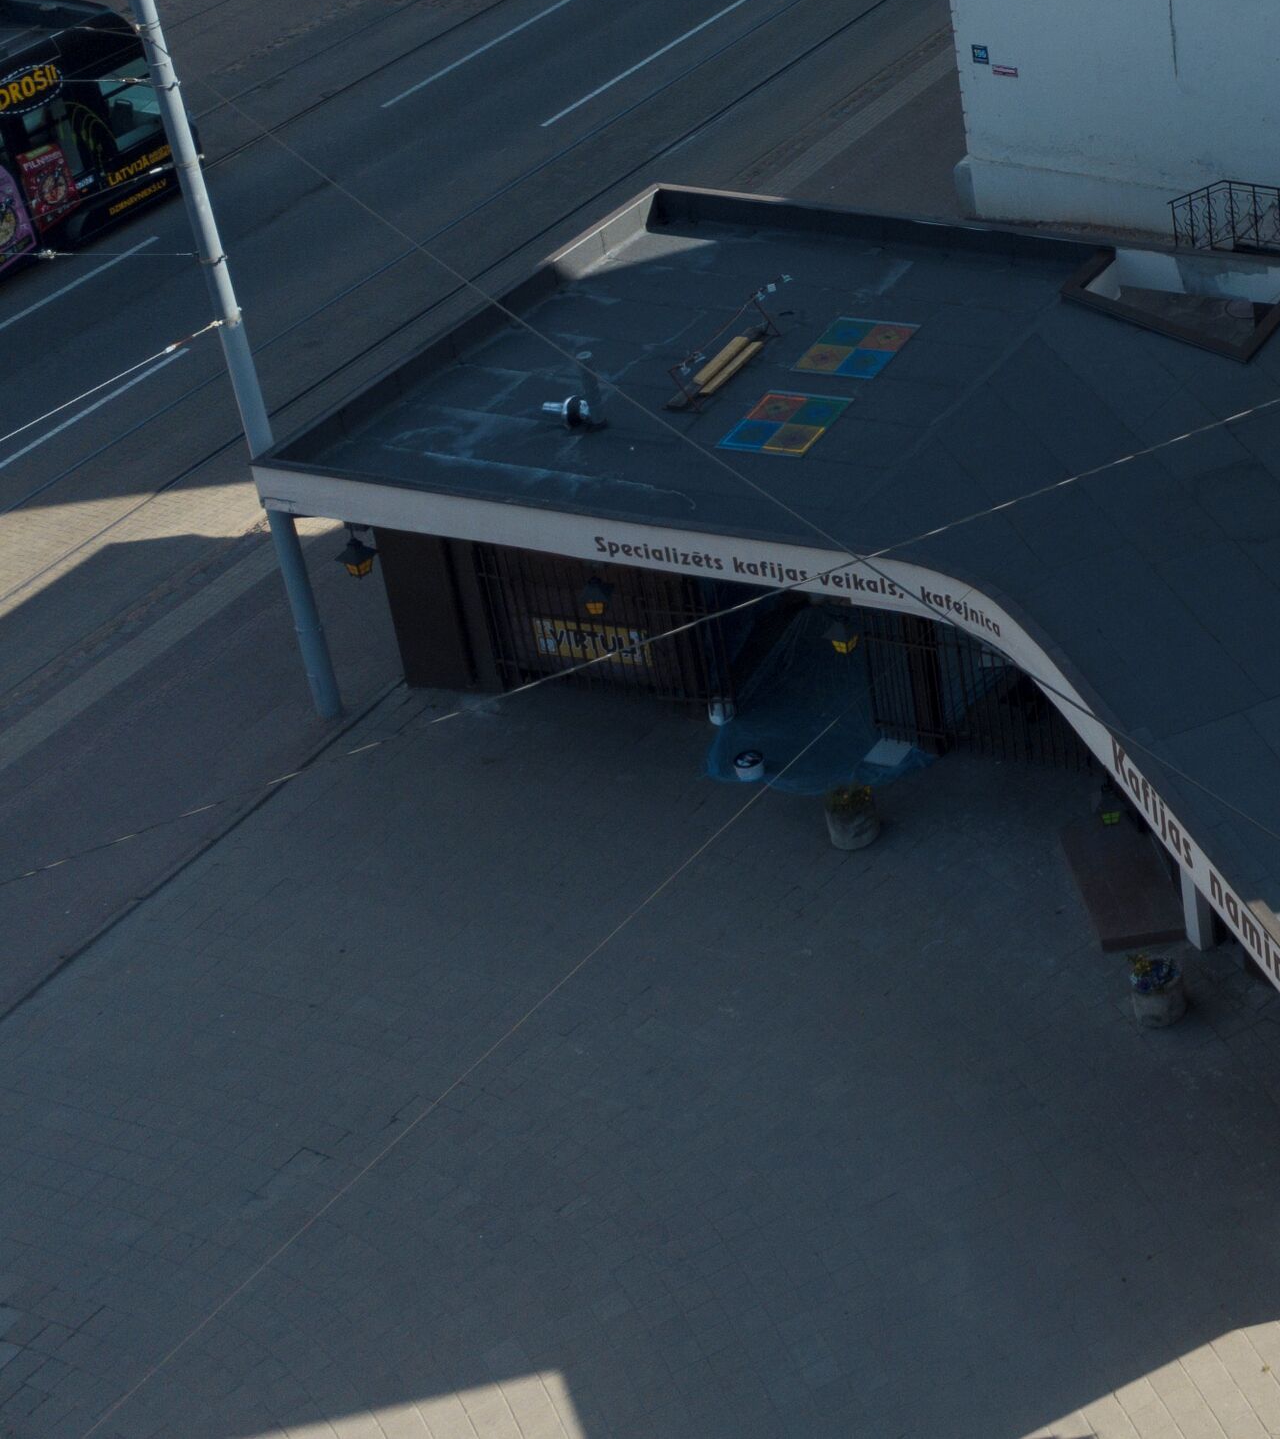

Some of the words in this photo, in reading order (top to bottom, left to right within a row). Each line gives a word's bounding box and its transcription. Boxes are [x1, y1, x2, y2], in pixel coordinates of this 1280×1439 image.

[594, 536, 724, 571] Specializēts
[733, 557, 808, 583] kafijas
[920, 586, 1002, 637] kafejnīca
[1111, 736, 1195, 869] Kafijas
